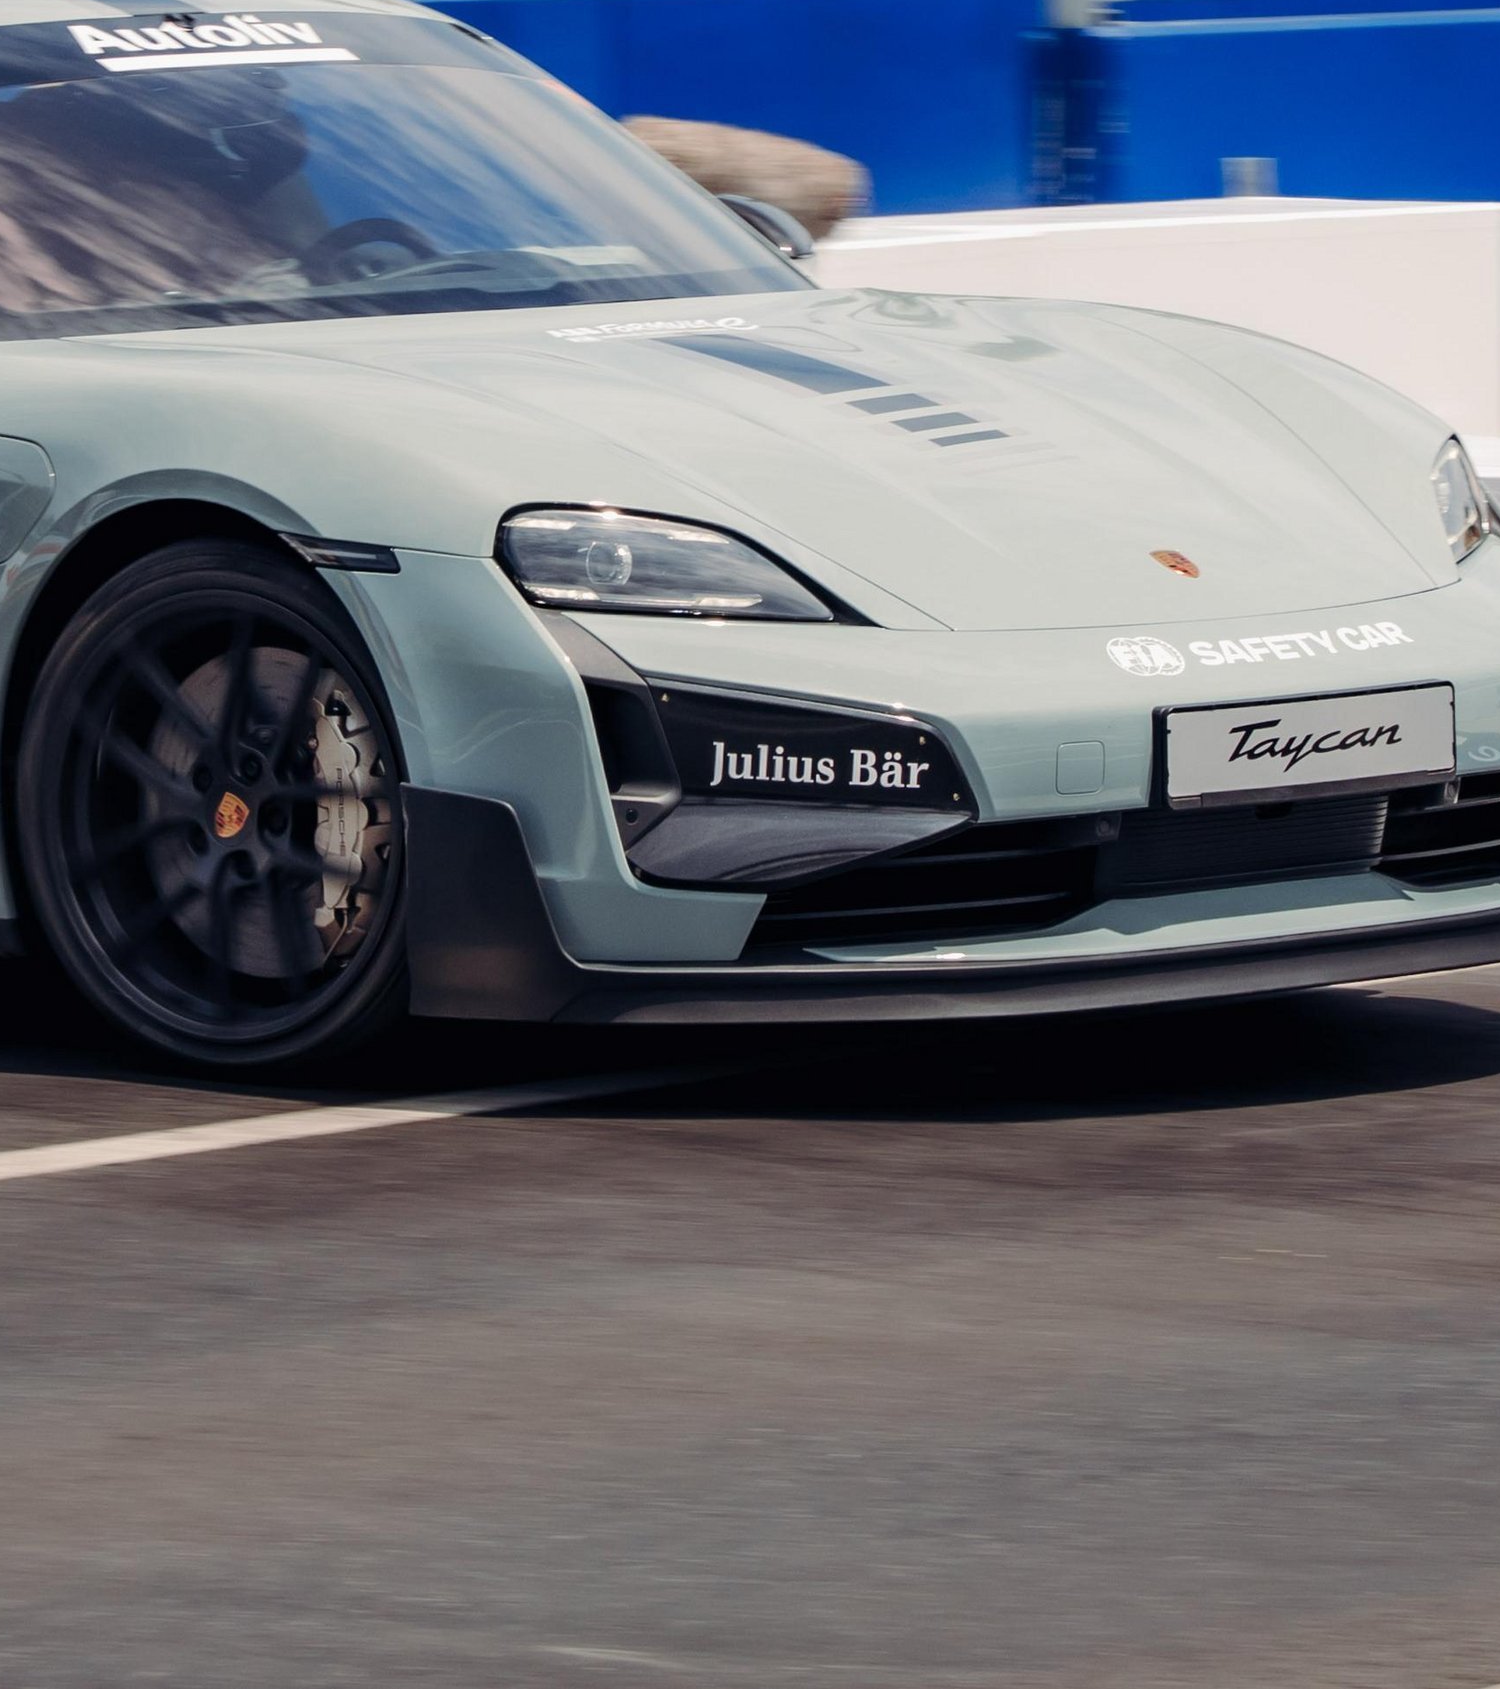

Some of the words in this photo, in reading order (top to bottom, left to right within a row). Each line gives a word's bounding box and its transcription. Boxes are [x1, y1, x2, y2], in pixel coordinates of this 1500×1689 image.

[67, 14, 323, 55] Autoliv
[1189, 630, 1338, 666] SAFETY
[1336, 621, 1415, 651] CAR
[710, 741, 835, 786] Julius
[849, 749, 929, 788] Bär
[1228, 719, 1402, 773] Taycan
[335, 767, 347, 857] PORSCHE
